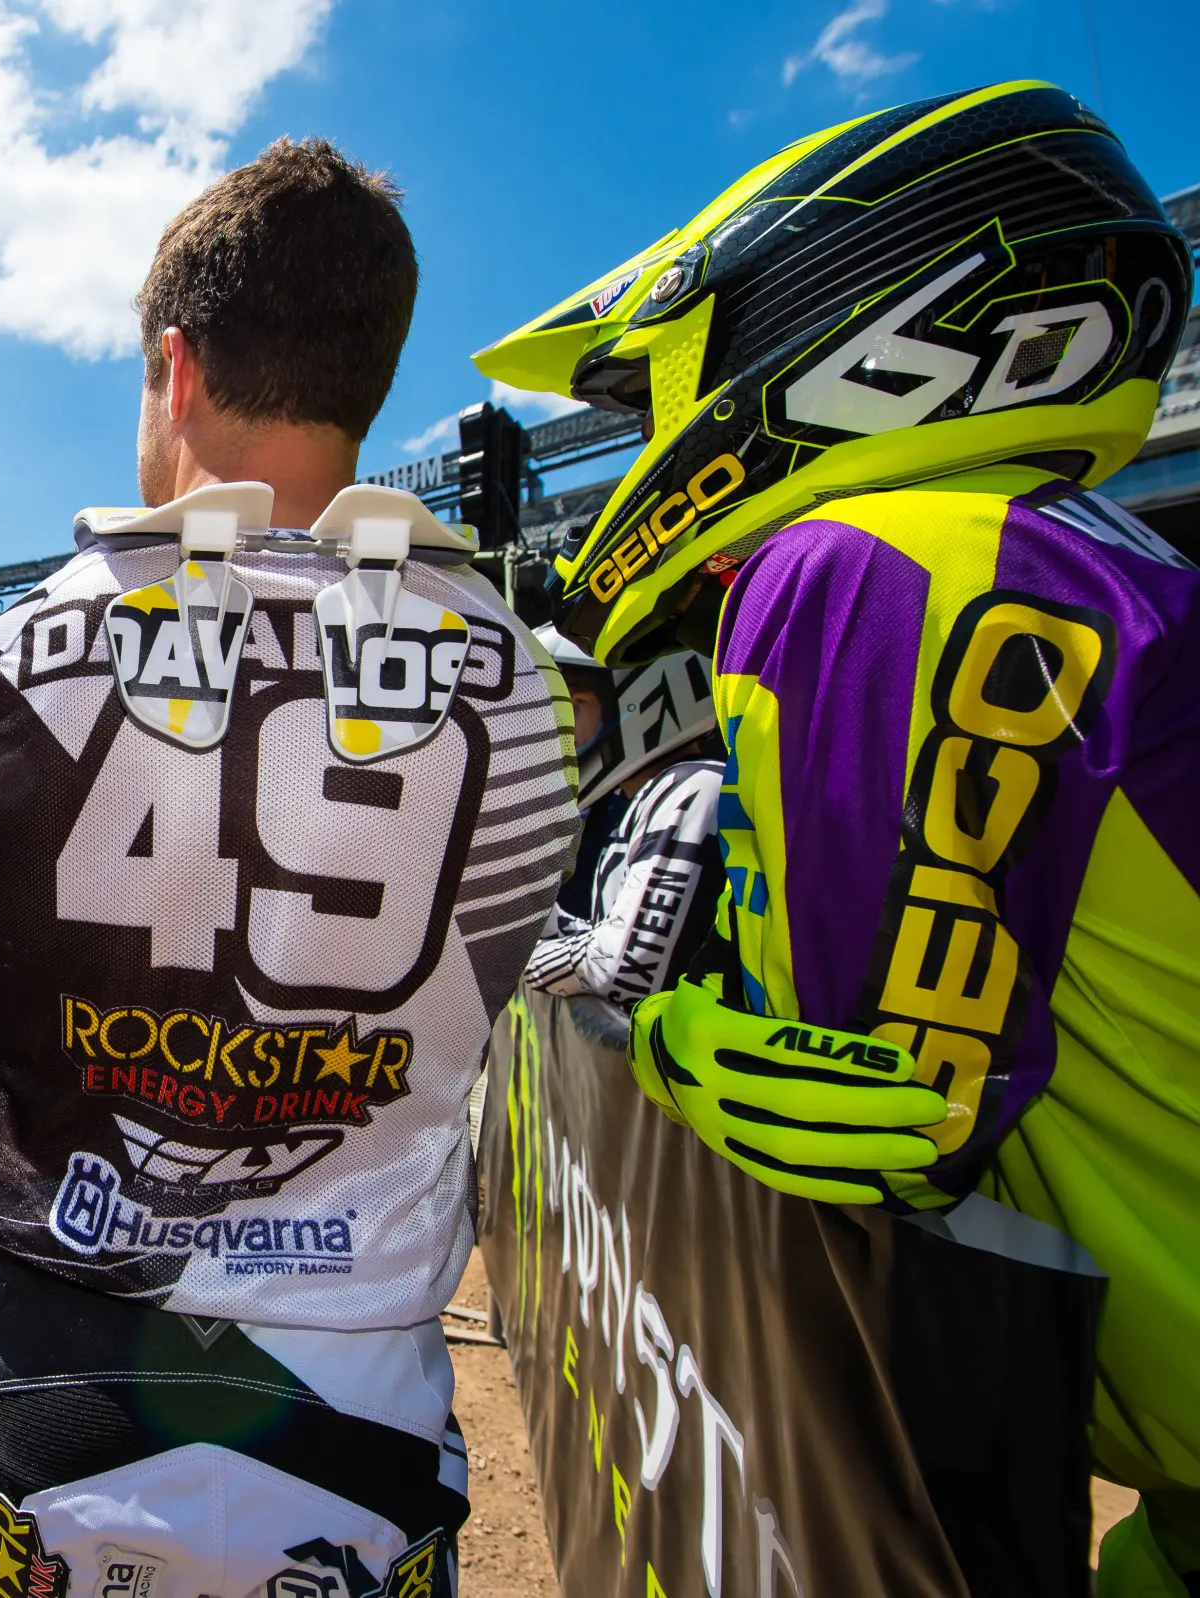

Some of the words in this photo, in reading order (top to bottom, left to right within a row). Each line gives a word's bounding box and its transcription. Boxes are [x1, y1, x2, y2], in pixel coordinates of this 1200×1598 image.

[584, 528, 613, 568] Advanced
[611, 496, 639, 529] Impact
[637, 453, 676, 496] Defense
[589, 453, 746, 603] GEICO
[56, 690, 470, 993] 49
[87, 1063, 237, 1123] ENERGY
[253, 1088, 371, 1124] DRINK
[105, 1200, 353, 1259] Husqvarna
[225, 1262, 293, 1276] FACTORY
[299, 1262, 353, 1276] RACING
